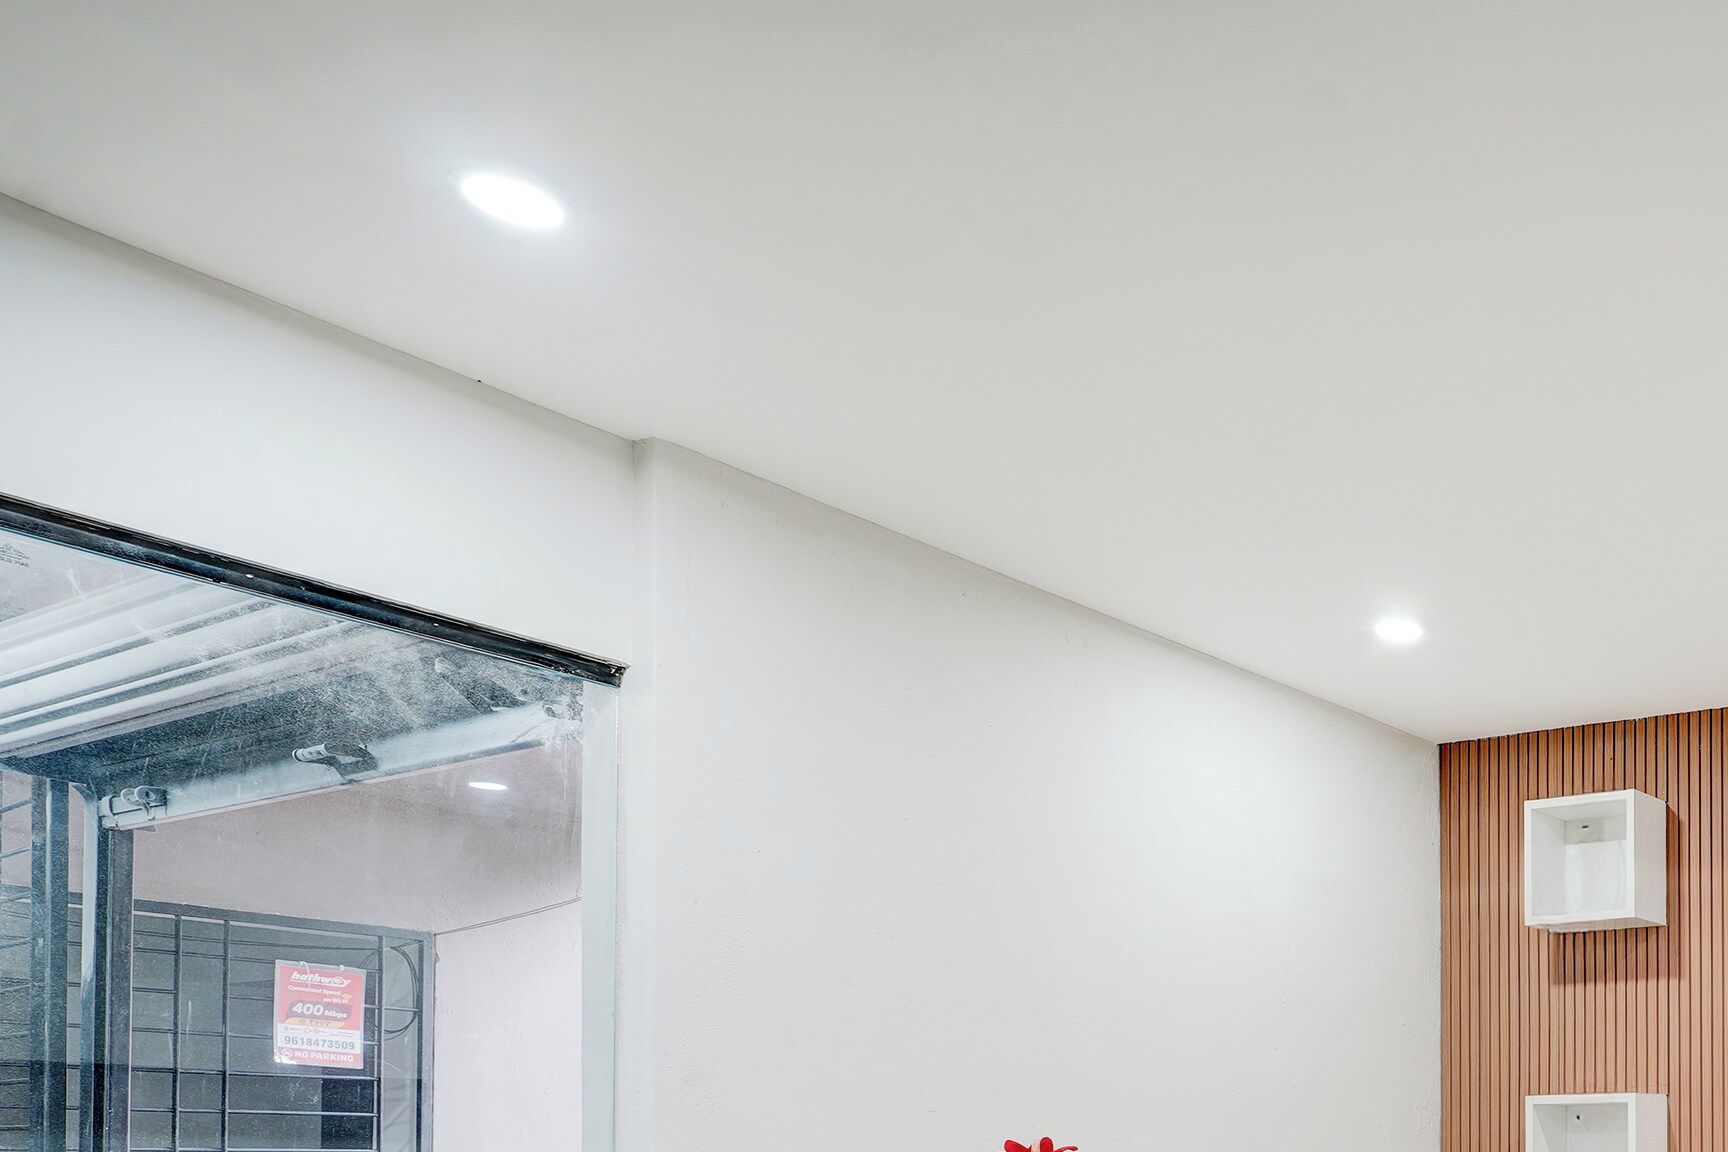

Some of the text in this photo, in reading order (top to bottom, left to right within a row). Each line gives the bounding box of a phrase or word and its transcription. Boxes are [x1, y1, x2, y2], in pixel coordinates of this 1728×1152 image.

[292, 1002, 348, 1019] 400 Mbps
[284, 1035, 355, 1050] 9618473509
[295, 1050, 354, 1062] NO PARKING
